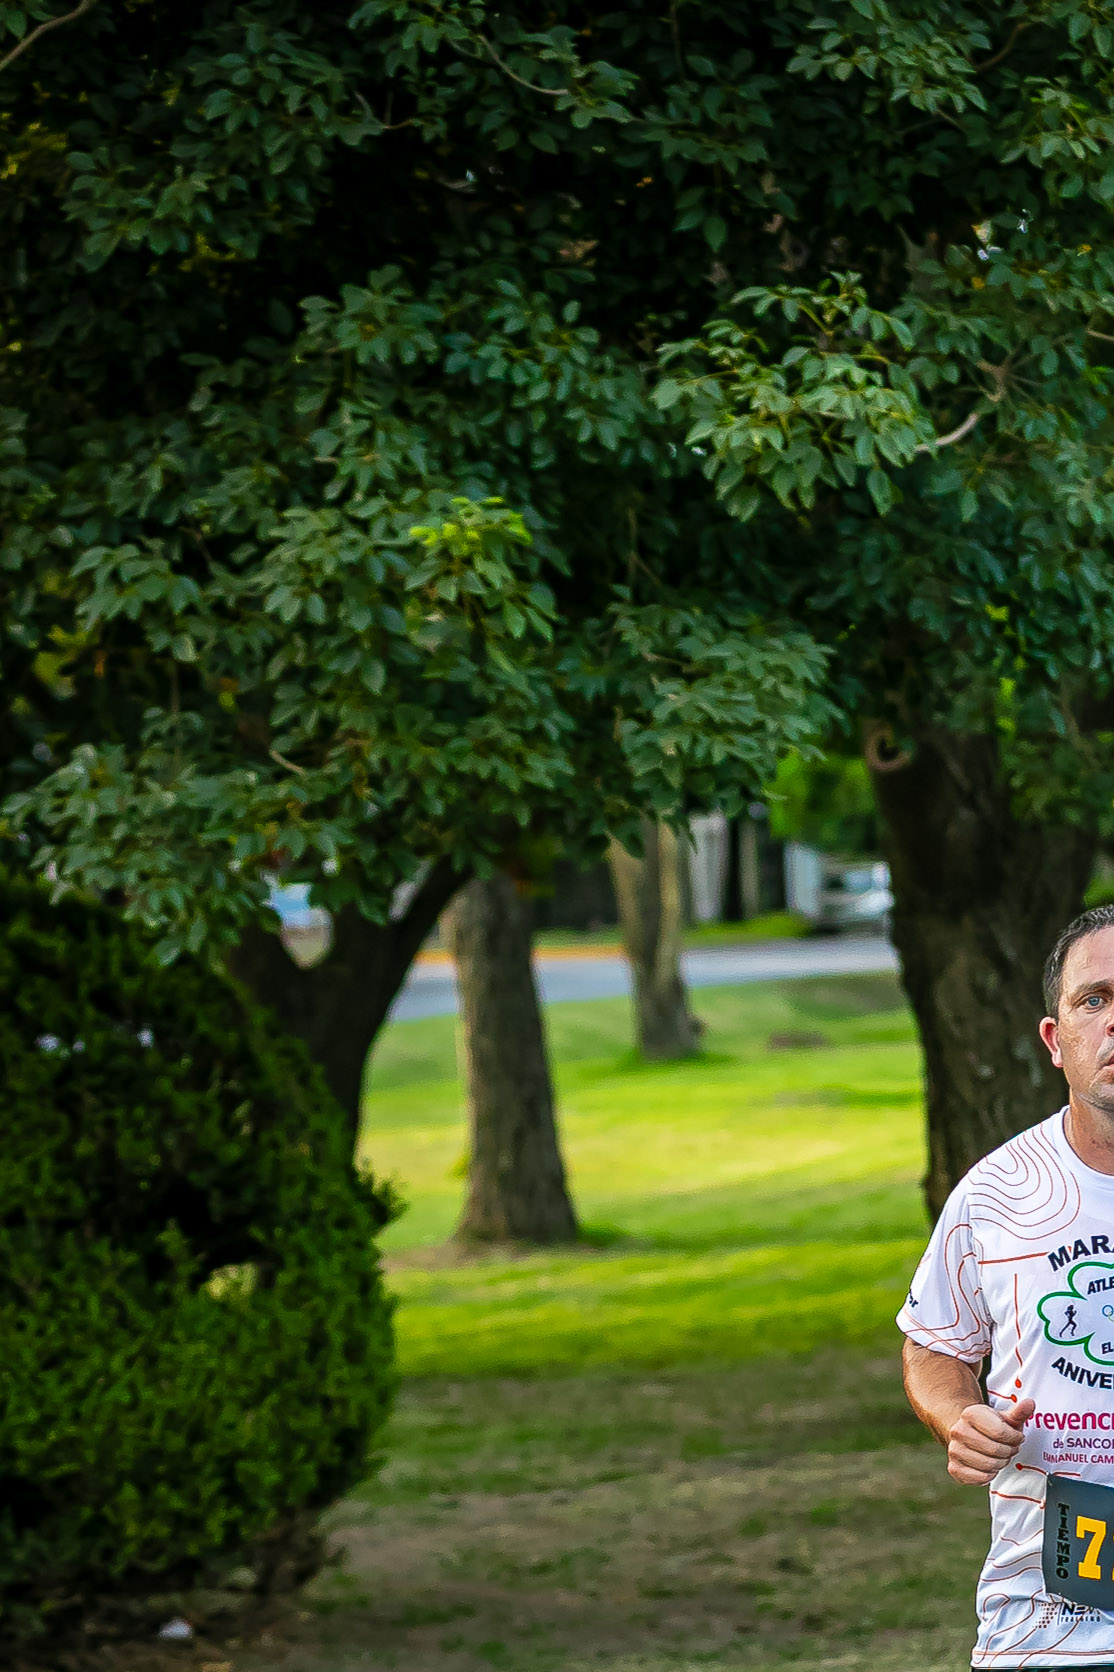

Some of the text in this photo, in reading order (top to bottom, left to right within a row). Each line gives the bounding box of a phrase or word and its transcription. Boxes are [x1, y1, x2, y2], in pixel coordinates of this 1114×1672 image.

[1101, 1341, 1114, 1354] EL
[1053, 1437, 1064, 1449] de
[1055, 1502, 1070, 1580] TIEMPO
